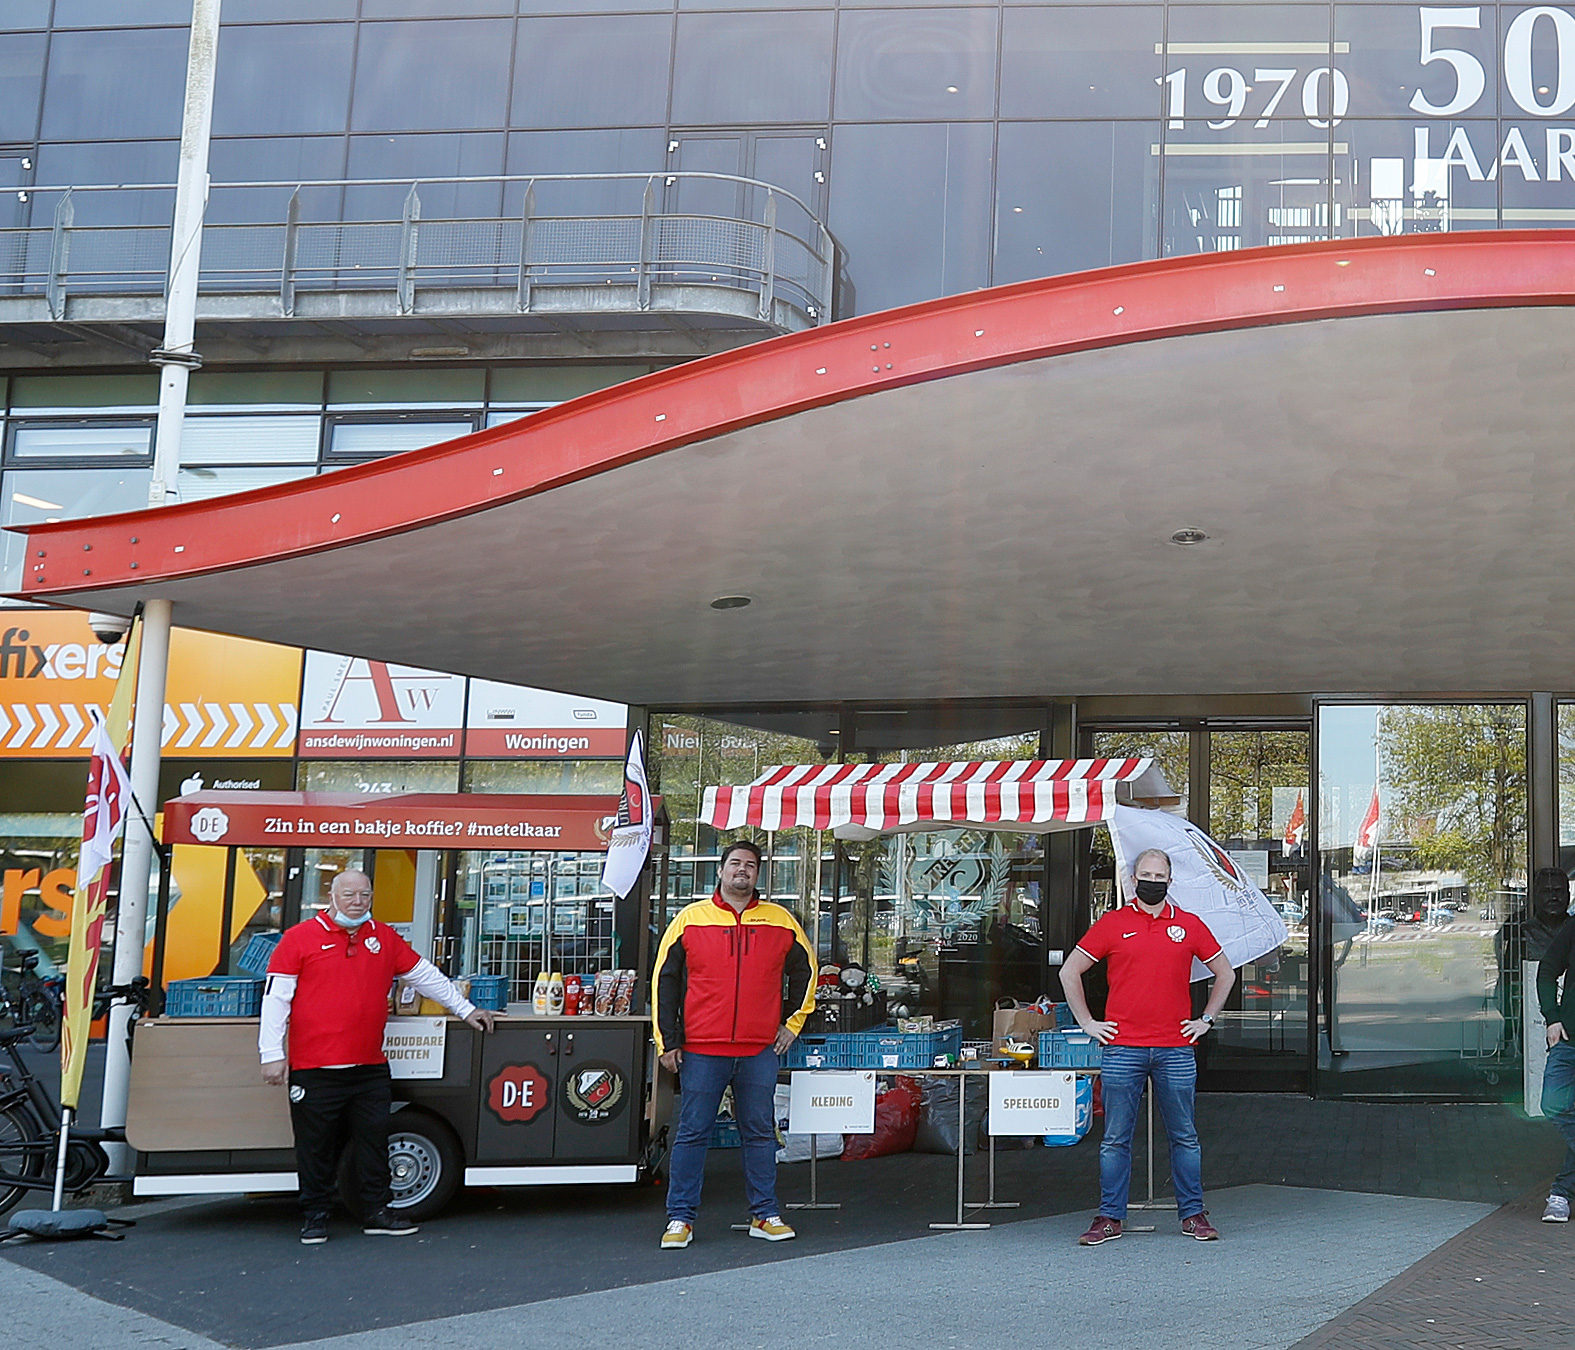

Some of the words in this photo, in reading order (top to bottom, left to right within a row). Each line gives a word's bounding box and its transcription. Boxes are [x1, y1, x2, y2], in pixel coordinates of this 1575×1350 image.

[1154, 67, 1350, 131] 1970
[305, 734, 454, 750] ansdewijnwoningen.nl
[505, 733, 589, 753] Woningen
[212, 779, 261, 790] Authorised
[264, 818, 293, 833] Zin
[297, 818, 315, 834] in
[319, 822, 350, 834] een
[354, 819, 402, 838] bakje
[404, 820, 464, 837] koffie?
[467, 821, 562, 838] #metelkaar
[386, 1036, 444, 1047] HOUDBARE
[383, 1049, 430, 1060] ODUCTEN
[811, 1096, 853, 1108] KLEDING
[1003, 1098, 1060, 1109] SPEELGOED
